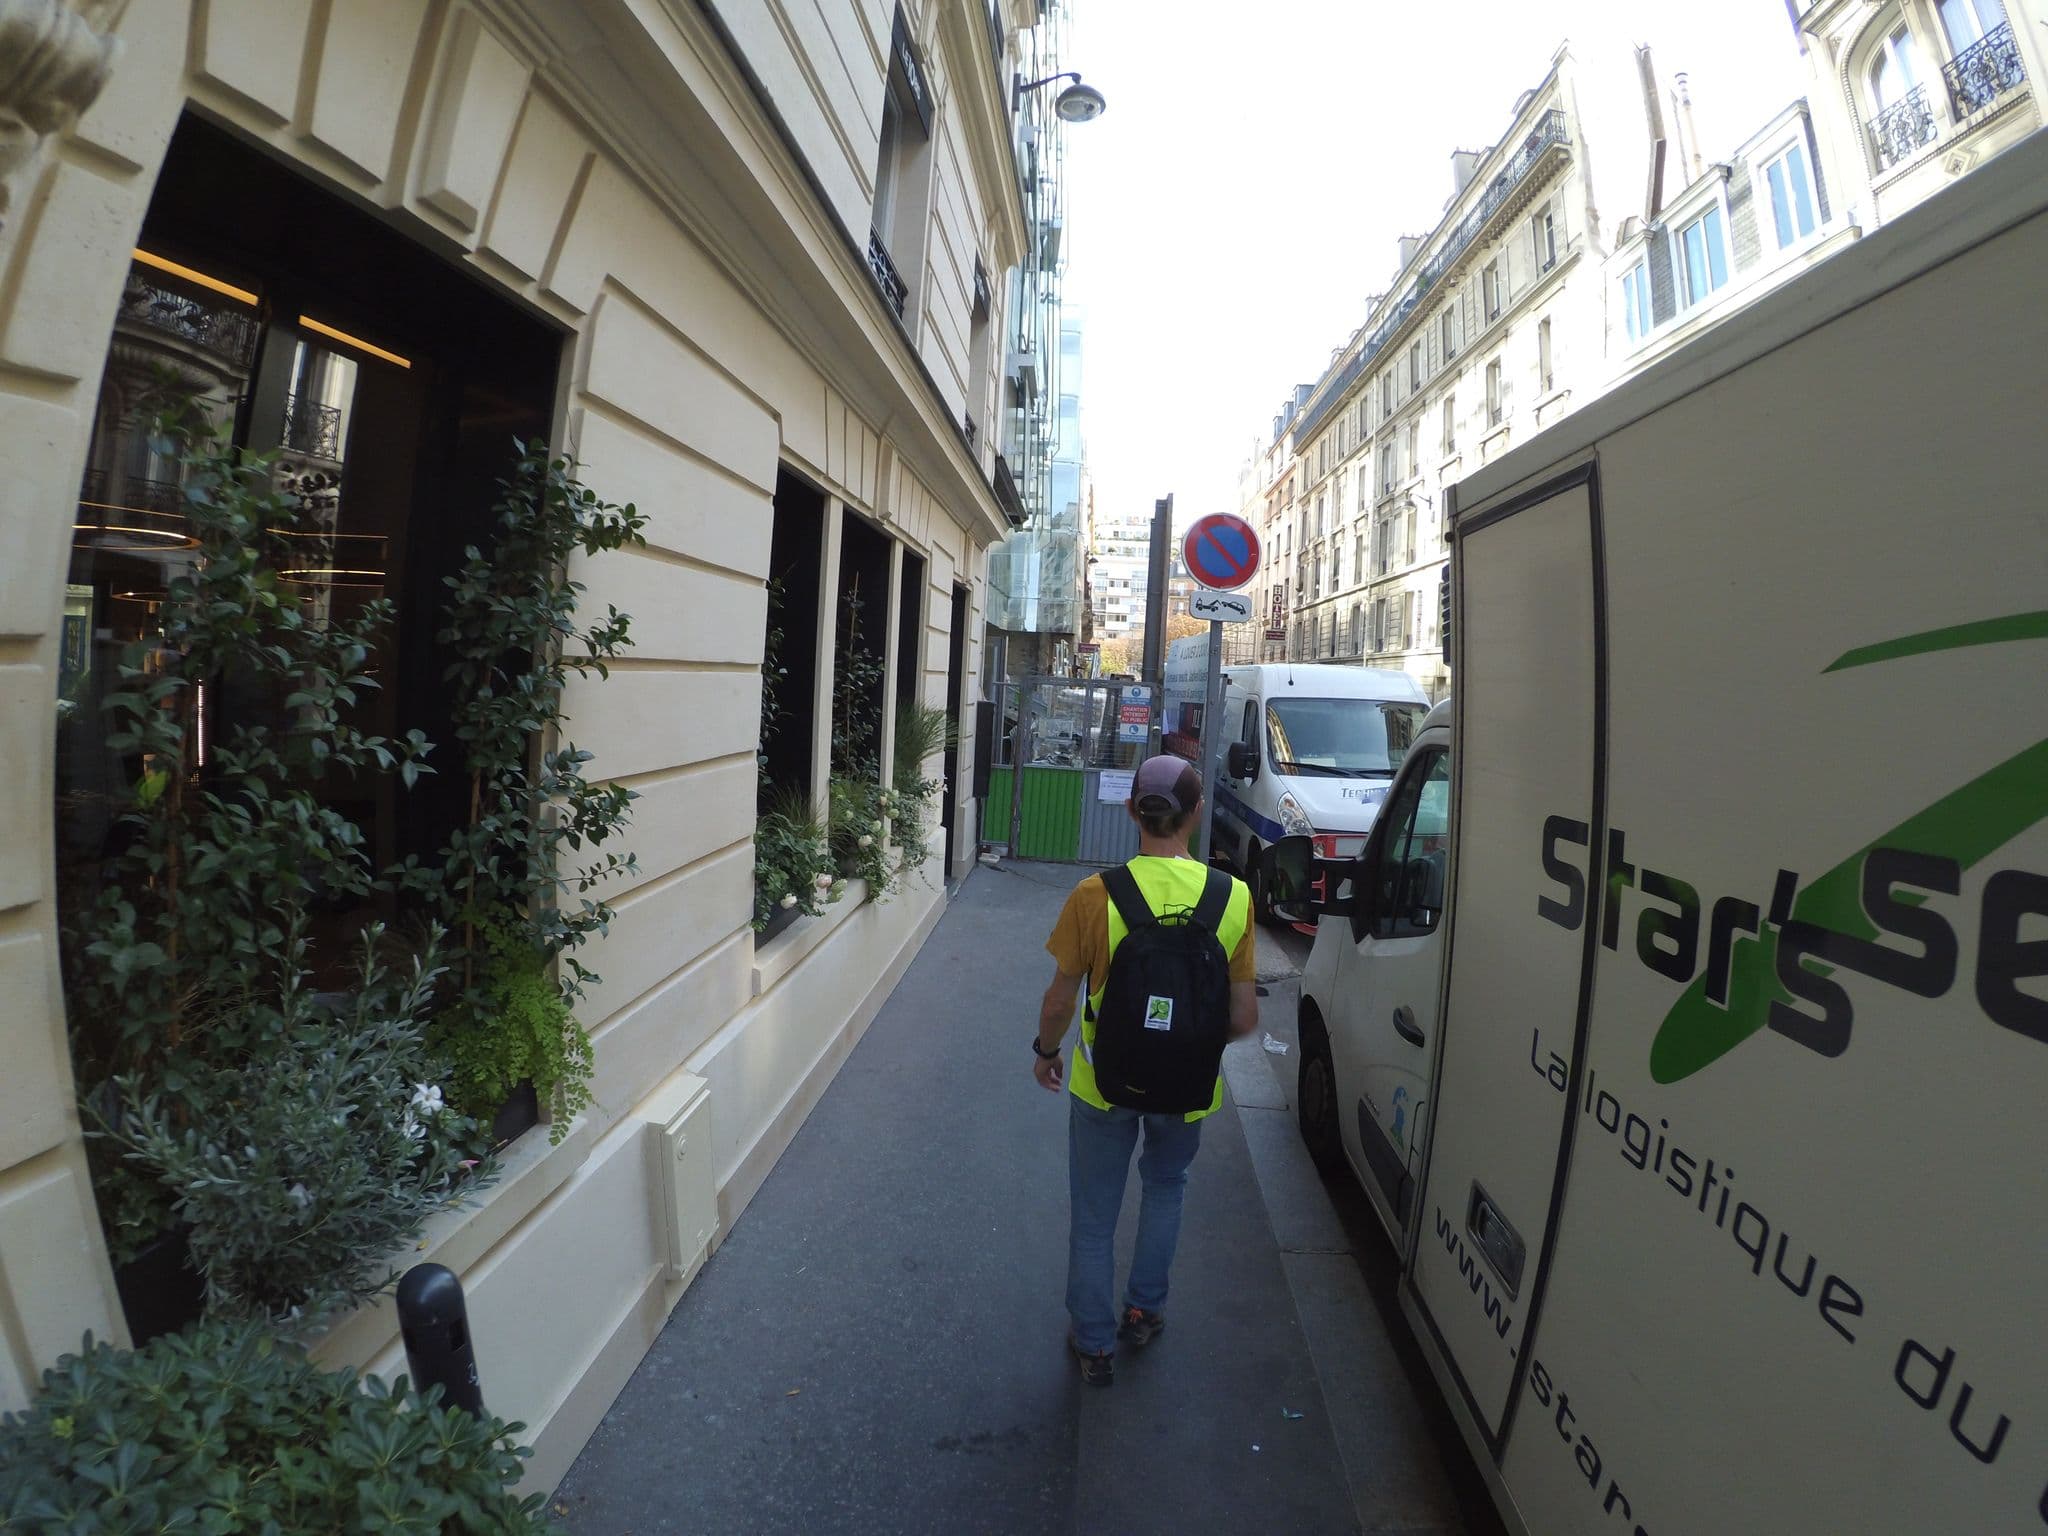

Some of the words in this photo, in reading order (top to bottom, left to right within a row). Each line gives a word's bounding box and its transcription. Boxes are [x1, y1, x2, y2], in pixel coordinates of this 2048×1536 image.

[1272, 586, 1282, 629] HOTEL
[1530, 1027, 1569, 1094] La
[1585, 1069, 1865, 1344] logistique
[1893, 1337, 2012, 1464] du
